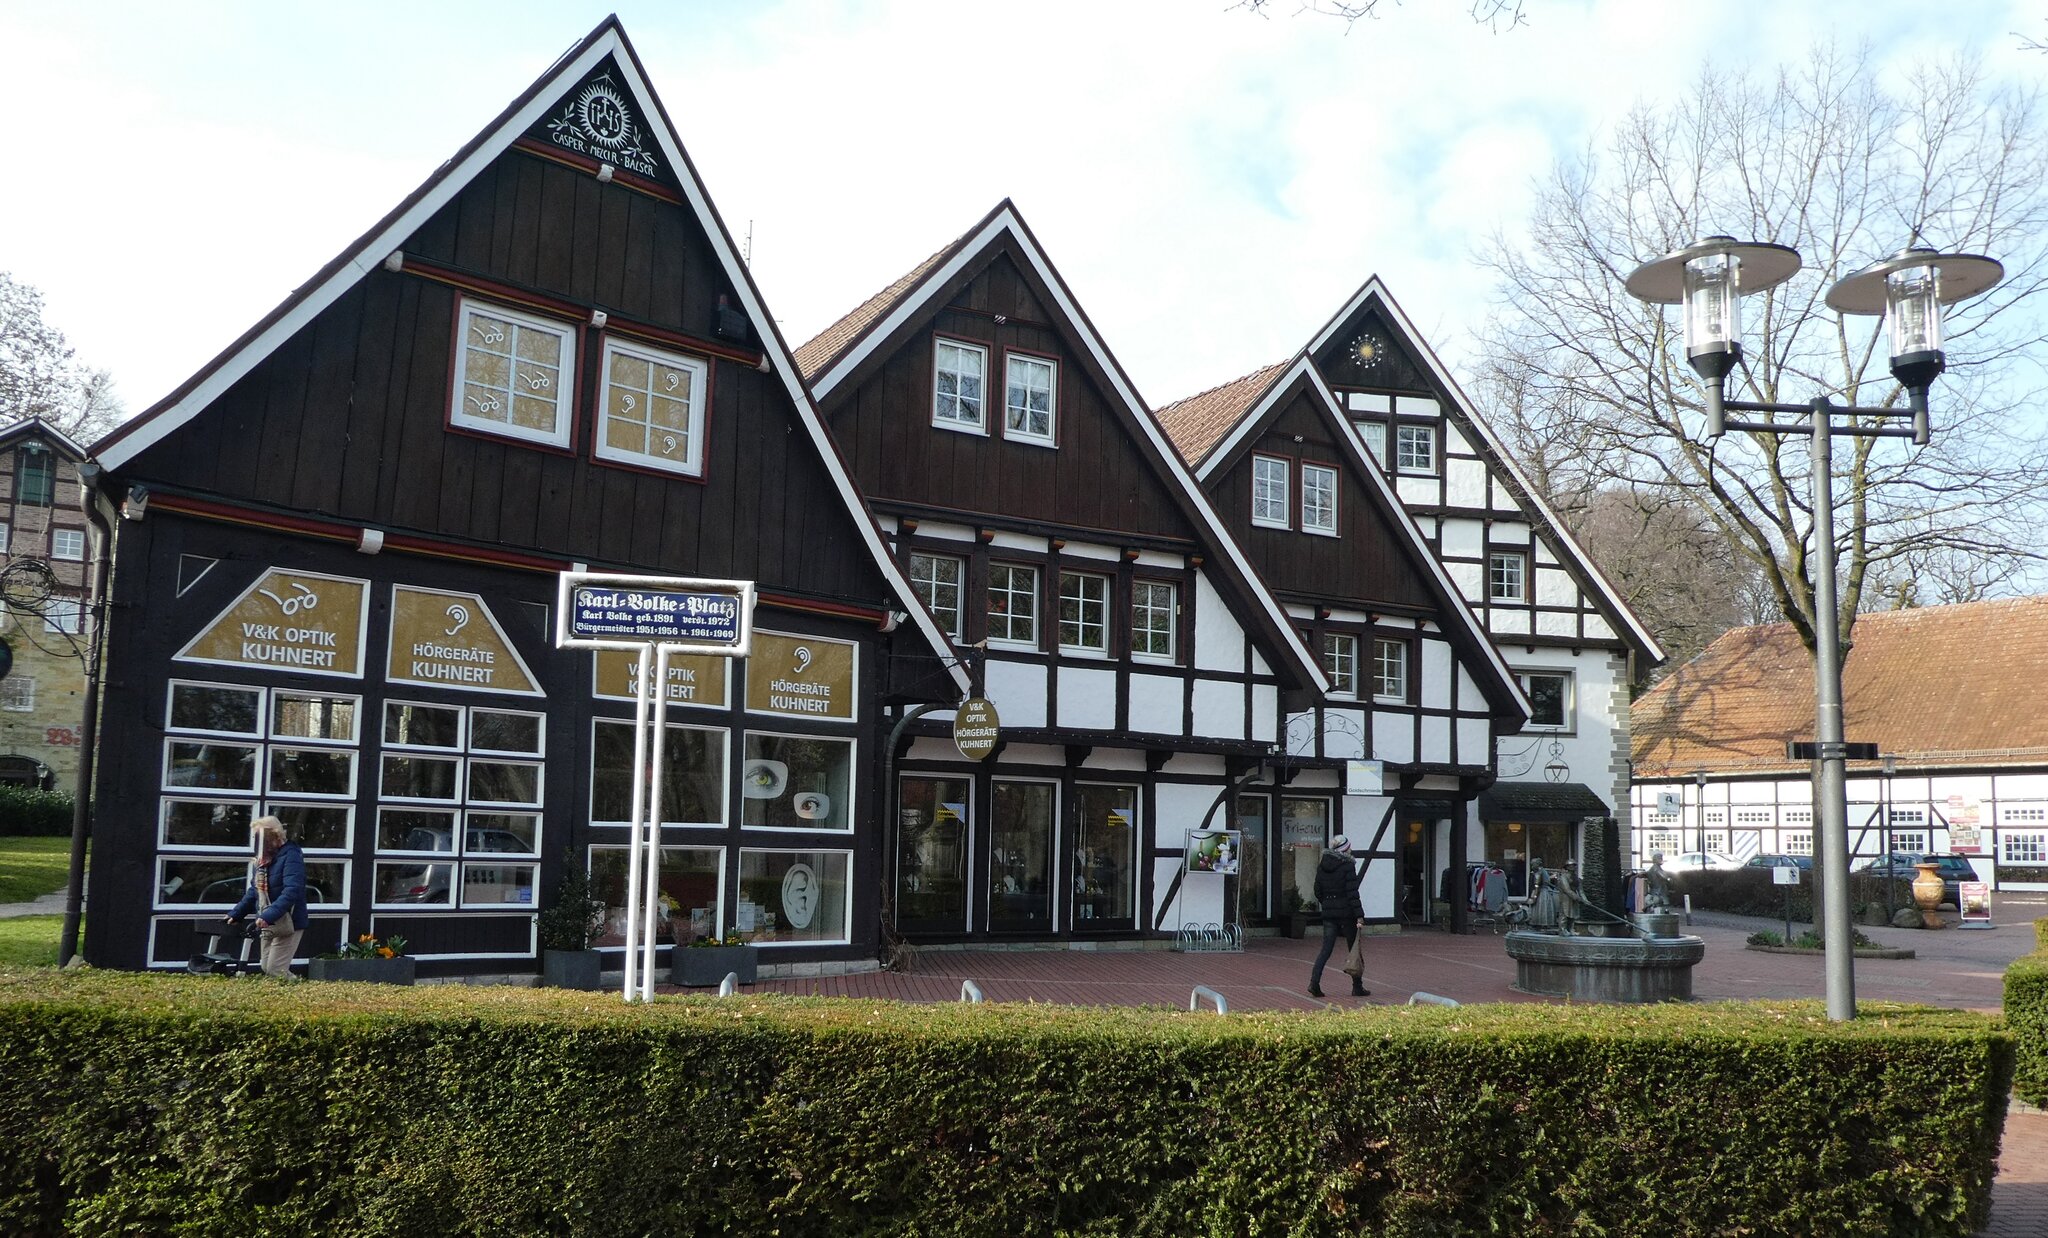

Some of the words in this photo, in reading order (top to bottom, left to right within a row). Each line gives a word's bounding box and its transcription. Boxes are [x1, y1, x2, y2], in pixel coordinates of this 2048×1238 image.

[552, 132, 585, 152] CASPER
[582, 610, 602, 620] Karl
[242, 622, 280, 640] V&K
[285, 627, 336, 647] OPTIK
[576, 622, 635, 633] Bürgermeister
[242, 642, 336, 667] KUHNERT
[413, 641, 495, 664] HÖRGERÄTE
[412, 661, 494, 683] KUHNERT
[628, 663, 655, 678] VK
[662, 667, 695, 682] PTIK
[628, 680, 696, 699] KHERT
[771, 678, 830, 696] HÖRGERÄTE
[770, 695, 830, 713] KUHNERT
[969, 702, 984, 711] V&K
[966, 713, 987, 723] OPTIK
[956, 727, 997, 737] HÖRGERÄTE
[960, 740, 993, 748] KUHNERT
